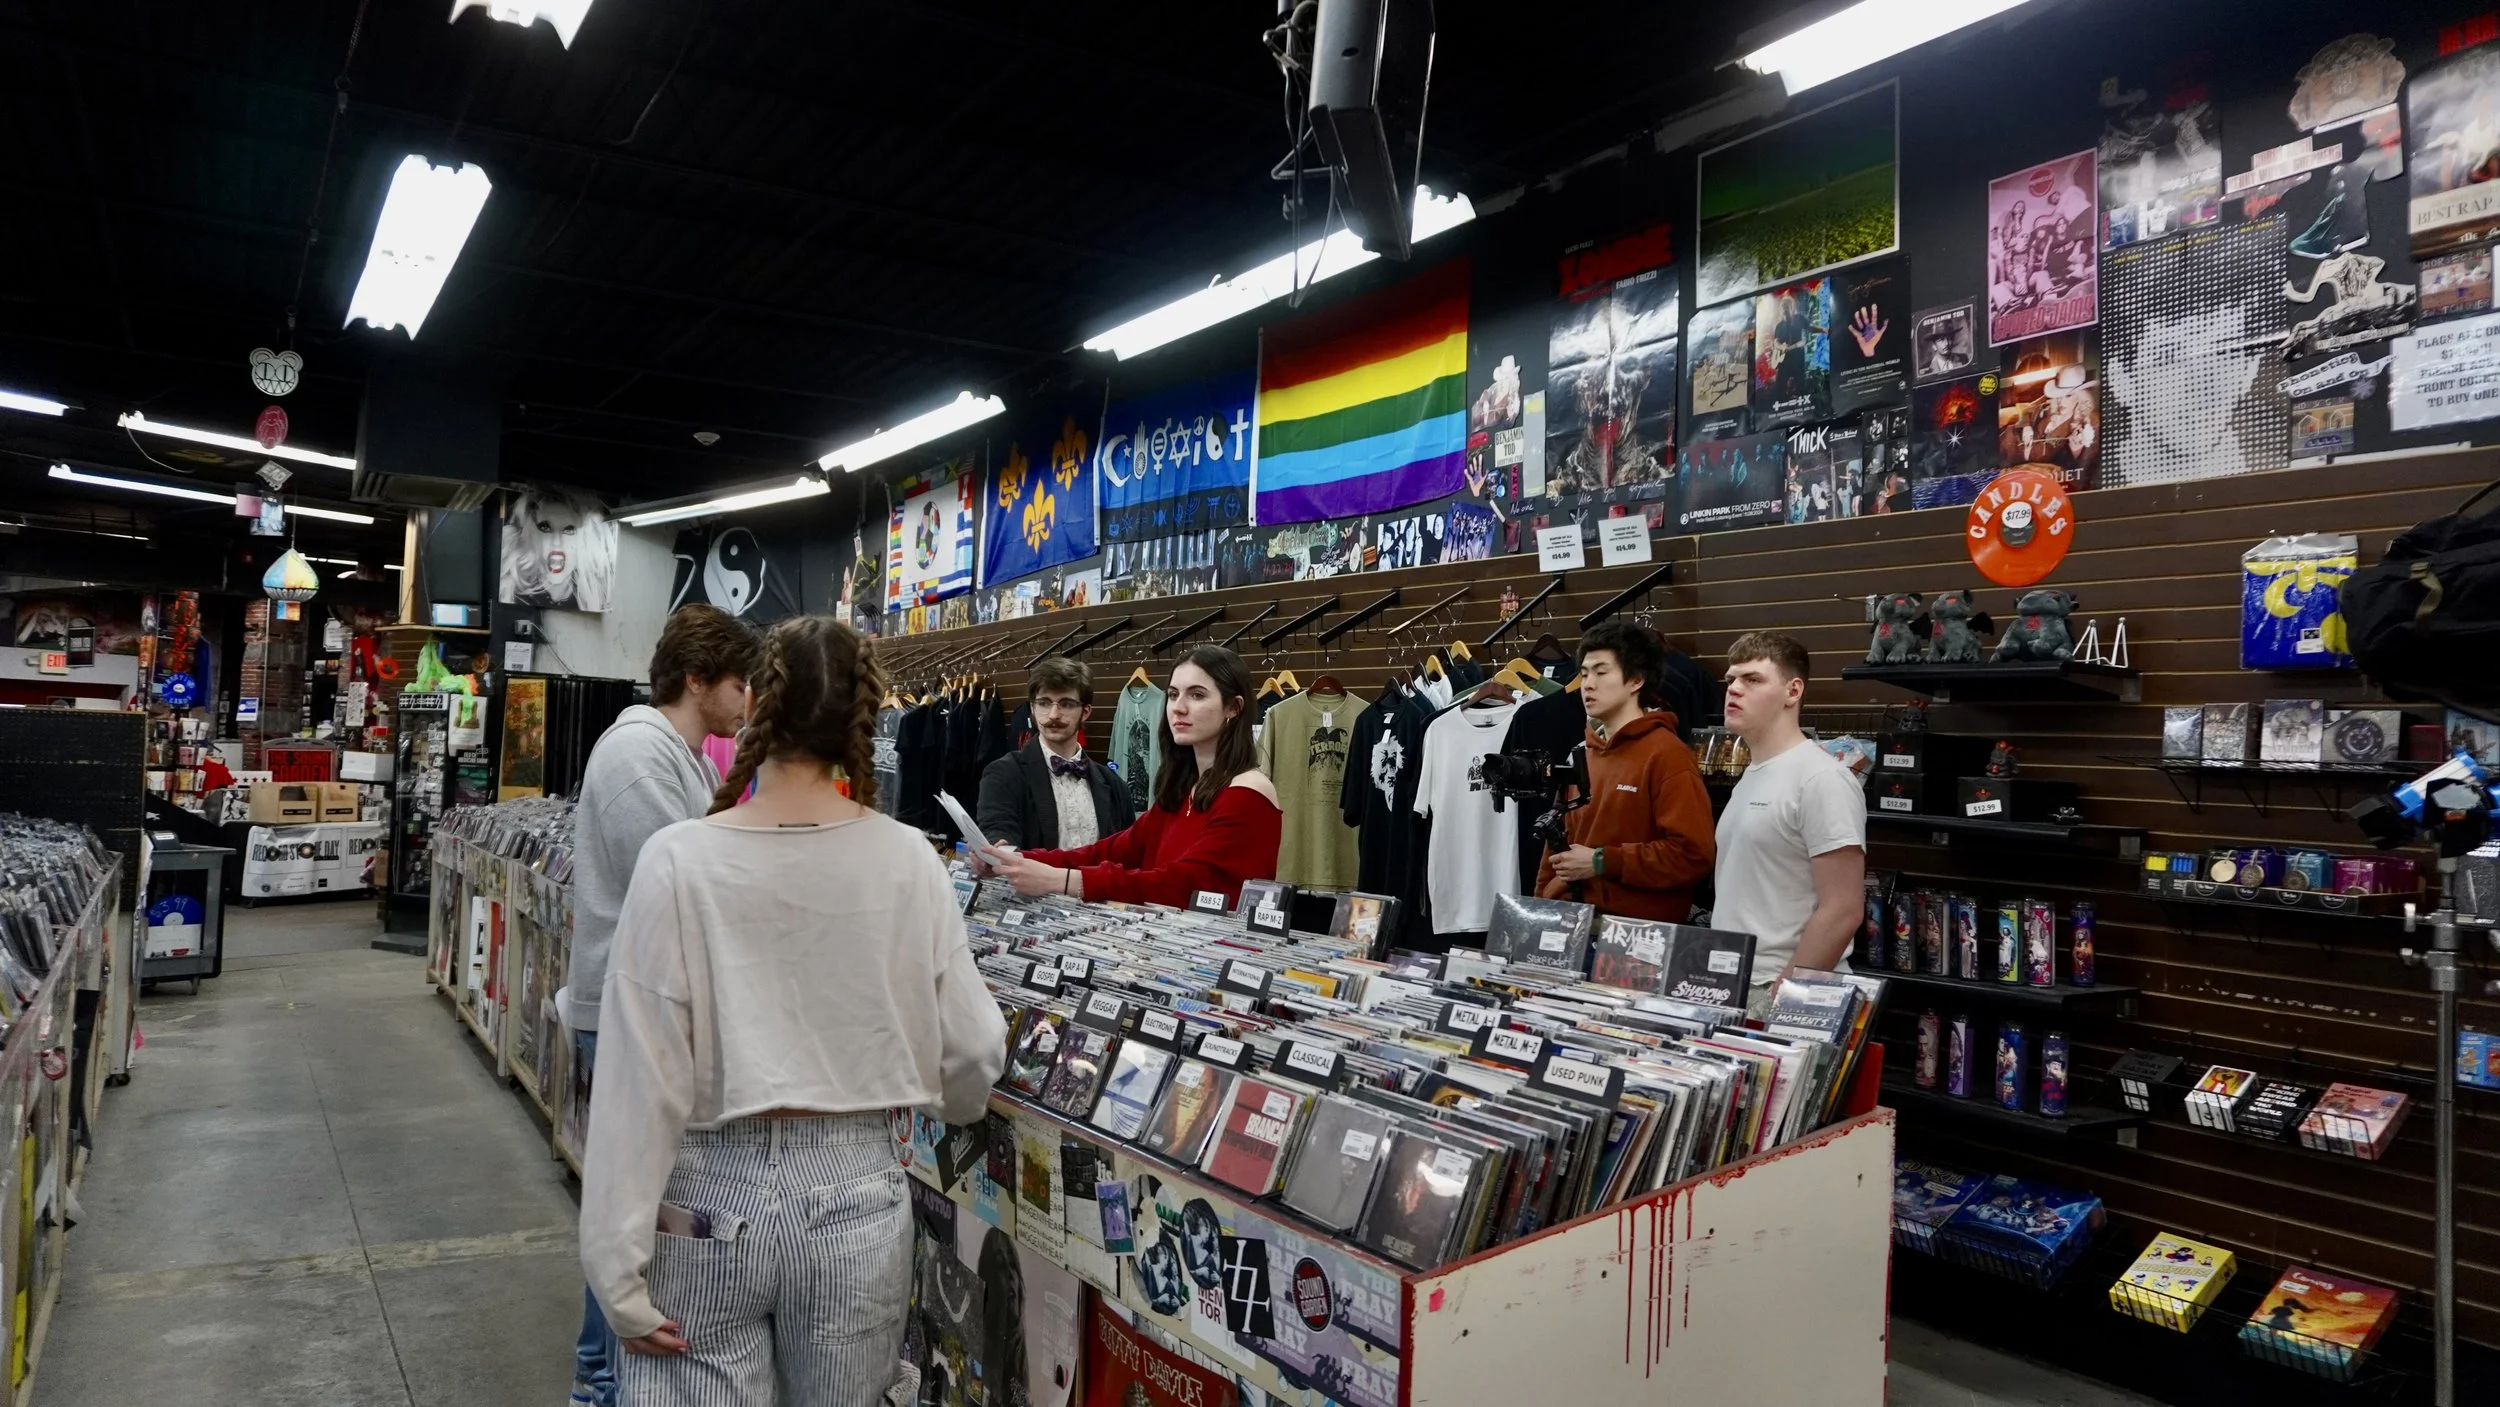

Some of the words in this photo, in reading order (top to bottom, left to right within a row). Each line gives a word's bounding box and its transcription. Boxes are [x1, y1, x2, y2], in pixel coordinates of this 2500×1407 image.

[2457, 197, 2492, 215] RAP
[2417, 333, 2454, 349] FLAGS
[2447, 392, 2470, 405] BUY
[1788, 426, 1831, 454] THICK
[2048, 468, 2084, 482] UET
[1690, 508, 1712, 519] LINKIN
[1712, 506, 1731, 516] PARK
[1732, 503, 1751, 514] FROM
[1752, 500, 1770, 511] ZERO
[1970, 482, 2068, 538] CANDLES
[2005, 509, 2031, 521] $17.99
[1616, 543, 1637, 552] $14.99
[1889, 757, 1909, 765] $12.99
[1886, 800, 1908, 809] $12.99
[1973, 803, 1996, 813] $12.99
[325, 840, 340, 857] DAY
[1201, 895, 1213, 905] R&B
[1213, 897, 1222, 907] S-Z
[1257, 910, 1270, 922] RAP
[1270, 913, 1282, 925] M-Z
[1064, 961, 1076, 972] RAP
[1076, 963, 1085, 974] A-L
[1232, 966, 1261, 984] INTERNATIONAL
[1037, 970, 1056, 984] GOSPEL
[1671, 980, 1731, 1000] SHADOWS
[1092, 999, 1118, 1015] REGGAE
[1145, 1016, 1175, 1035] ELECTRONIC
[1455, 1009, 1480, 1027] METAL
[1775, 1014, 1830, 1027] MOMENTS
[1204, 1041, 1238, 1058] SOUNDTRACKS
[1491, 1032, 1519, 1052] METAL
[1522, 1039, 1539, 1055] M-Z
[1291, 1050, 1332, 1069] CLASSICAL
[1551, 1064, 1576, 1081] USED
[1577, 1070, 1606, 1089] PUNK
[2268, 1082, 2291, 1090] HOW
[2260, 1091, 2296, 1102] SWEAR
[1298, 1276, 1325, 1299] SOUND
[1362, 1270, 1397, 1295] THE
[1301, 1296, 1329, 1318] GARDEN
[1340, 1278, 1398, 1326] FRAY
[1199, 1298, 1221, 1325] TOR
[1274, 1318, 1308, 1355] RAY
[1341, 1355, 1399, 1402] FRAY
